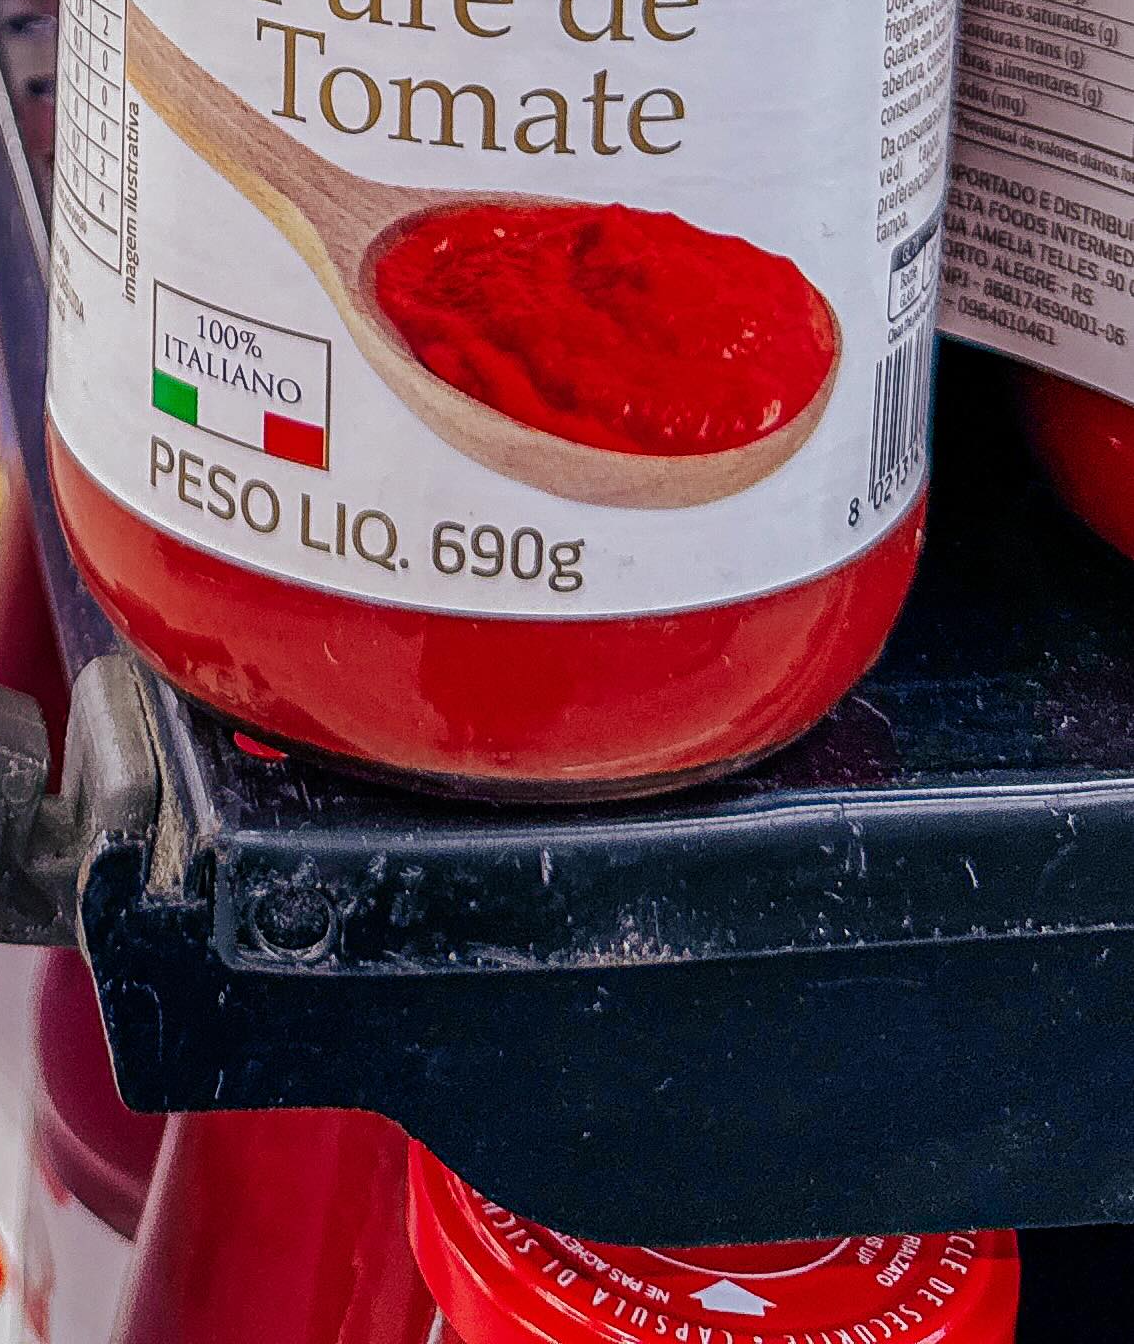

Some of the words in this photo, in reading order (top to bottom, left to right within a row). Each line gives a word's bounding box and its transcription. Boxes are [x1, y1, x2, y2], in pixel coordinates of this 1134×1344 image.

[255, 16, 685, 156] Tomate
[124, 100, 141, 214] ilustrativa
[880, 136, 895, 162] Da
[879, 154, 904, 188] vedi
[988, 199, 1049, 235] FOODS
[122, 216, 140, 305] imagem
[196, 313, 264, 361] 100%
[163, 332, 304, 406] ITALIANO
[149, 433, 282, 536] PESO
[299, 492, 411, 572] LIQ.
[431, 520, 586, 594] 690g
[848, 497, 861, 528] 8
[541, 1258, 580, 1289] DI
[608, 1267, 644, 1293] PAS
[643, 1283, 671, 1305] NE
[916, 1276, 955, 1308] DE
